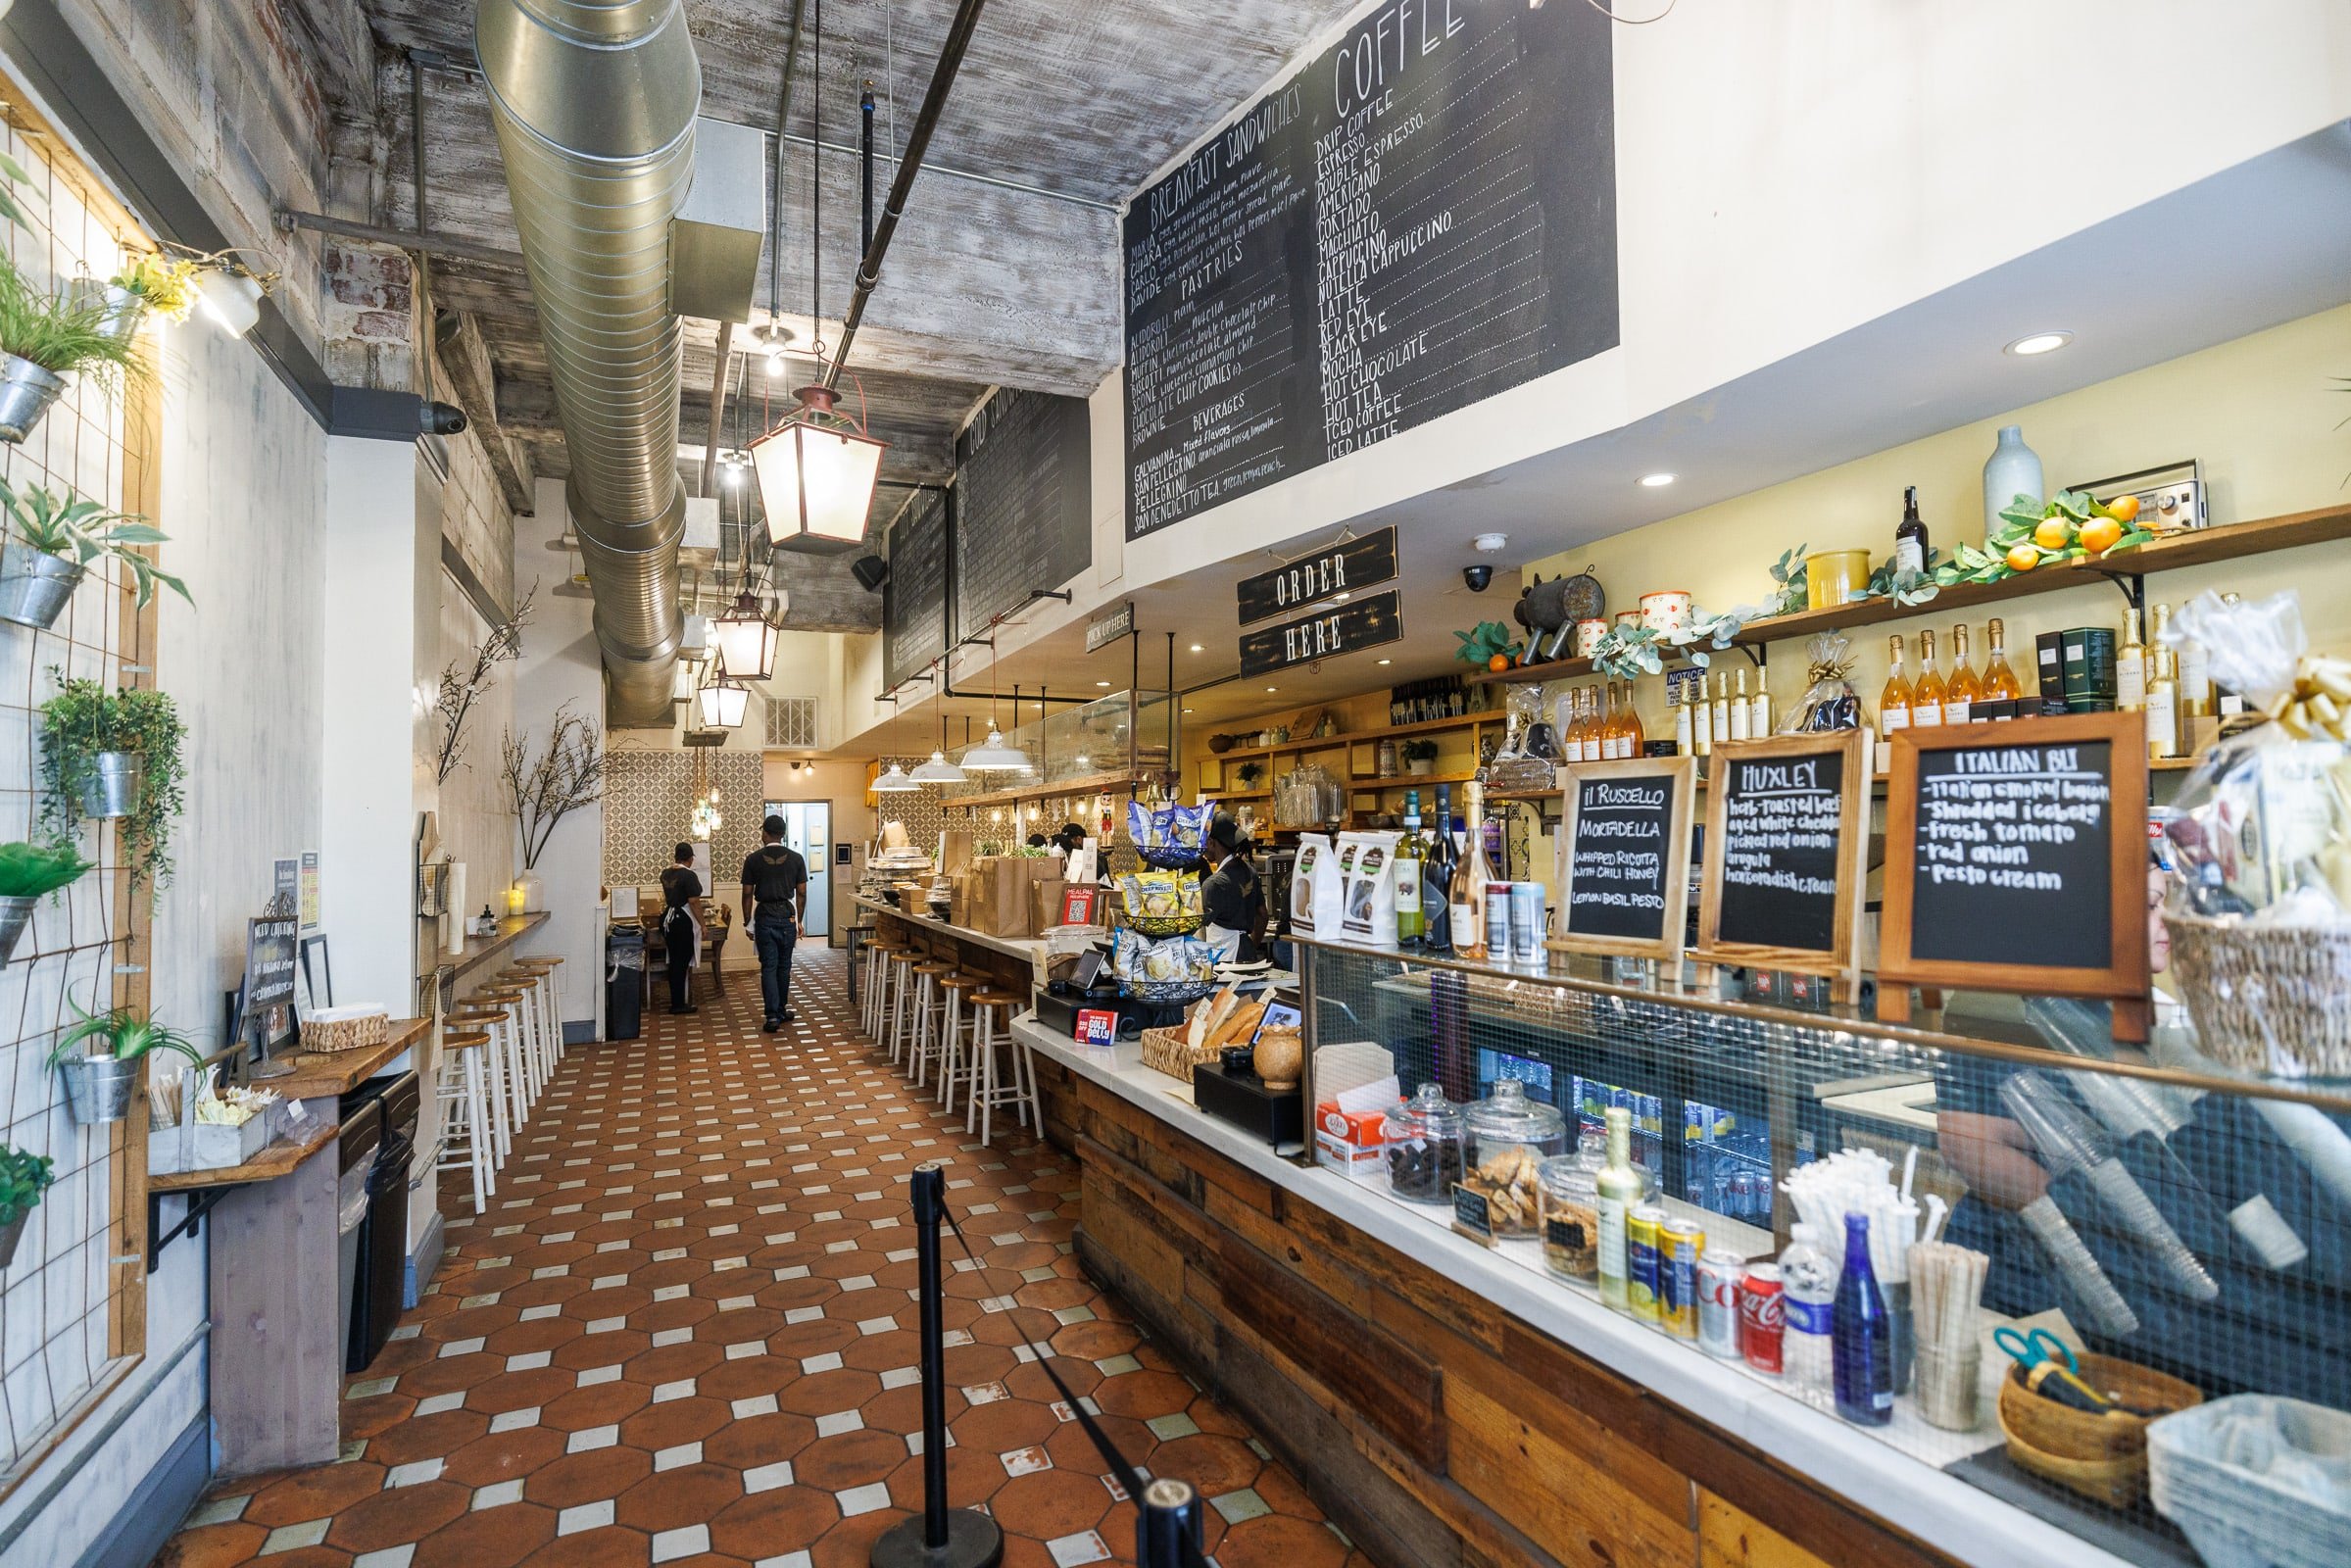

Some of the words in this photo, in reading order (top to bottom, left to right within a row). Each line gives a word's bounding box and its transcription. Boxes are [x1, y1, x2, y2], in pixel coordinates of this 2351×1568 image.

[1314, 125, 1343, 165] DRIP
[1347, 88, 1394, 138] COFFEE
[1151, 141, 1221, 232] BREAKFAST
[1226, 82, 1301, 169] SANDWICHES
[1316, 157, 1358, 204] DOUBLE
[1364, 113, 1424, 167] ESPRESSO
[1317, 132, 1365, 180] ESPRESSO
[1317, 163, 1381, 224] AMERICANO
[1317, 192, 1371, 245] CORTADO
[1317, 211, 1379, 266] MACCHIATO
[1130, 244, 1162, 279] CHIARA
[1131, 233, 1155, 264] MARIA
[1317, 228, 1387, 285] CAPPUCCINO
[1317, 259, 1368, 306] NUTELLA
[1372, 211, 1452, 274] CAPPUCCINO
[1131, 266, 1156, 297] CARLO
[1181, 240, 1243, 301] PASTRIES
[1130, 276, 1162, 316] DAVIDE
[1318, 281, 1365, 326] LATTE
[1319, 317, 1342, 348] RED
[1347, 298, 1372, 332] EYE
[1321, 328, 1357, 367] BLACK
[1360, 311, 1388, 343] EYE
[1131, 367, 1162, 400] BISCOTTI
[1223, 314, 1256, 346] almond
[1131, 354, 1158, 383] MUFFIN
[1321, 347, 1363, 387] MOCHA
[1322, 374, 1348, 408] HOT
[1350, 331, 1429, 391] CHOCOLATE
[1132, 392, 1174, 433] CHOCOLATE
[1177, 379, 1198, 405] CHIP
[1198, 363, 1231, 394] COOKIES
[1132, 385, 1156, 416] SCONE
[1193, 393, 1245, 432] BEVERAGES
[1324, 396, 1349, 428] HOT
[1352, 380, 1383, 413] TEA
[1324, 416, 1353, 444] ICED
[1356, 393, 1402, 428] COFFEE
[970, 408, 987, 456] COLD
[1132, 415, 1166, 452] BROWNIE
[1327, 438, 1353, 463] ICED
[1358, 418, 1399, 449] LATTE
[1134, 447, 1174, 482] GALVANINA
[1183, 433, 1202, 454] Mixed
[1203, 424, 1231, 444] flavors
[1134, 477, 1150, 499] SAN
[1150, 451, 1196, 490] PELLEGRINO
[1135, 473, 1188, 514] PELLEGRINO
[1135, 510, 1151, 533] SAN
[1151, 488, 1200, 526] BENEDETTO
[1200, 479, 1219, 503] TEA
[1276, 553, 1347, 607] ORDER
[1087, 624, 1102, 645] PICK
[1102, 619, 1111, 637] UP
[1111, 610, 1130, 633] HERE
[1285, 615, 1342, 662] HERE
[1668, 668, 1704, 684] NOTICE
[1741, 760, 1817, 792] HUXLEY
[1954, 749, 2040, 774] ITALIAN
[1579, 818, 1660, 838] MORTADELLA
[1727, 833, 1768, 852] pickled
[1769, 831, 1791, 850] red
[1791, 831, 1832, 850] onion
[1728, 817, 1758, 836] aged
[1758, 815, 1795, 831] white
[1992, 821, 2077, 845] tomato
[1575, 851, 1616, 864] WHIPPED
[1616, 850, 1660, 866] RICOTTA
[1726, 852, 1772, 871] arugula
[1970, 843, 2030, 865] onion
[1574, 866, 1595, 878] WITH
[1596, 865, 1622, 880] CHILI
[1625, 865, 1660, 890] HONEY
[1725, 866, 1797, 892] horseradish
[1989, 868, 2063, 891] cream
[1572, 891, 1602, 905] LEMON
[1602, 891, 1632, 906] BASIL
[1632, 893, 1665, 909] PESTO
[1088, 1019, 1107, 1030] GOLD
